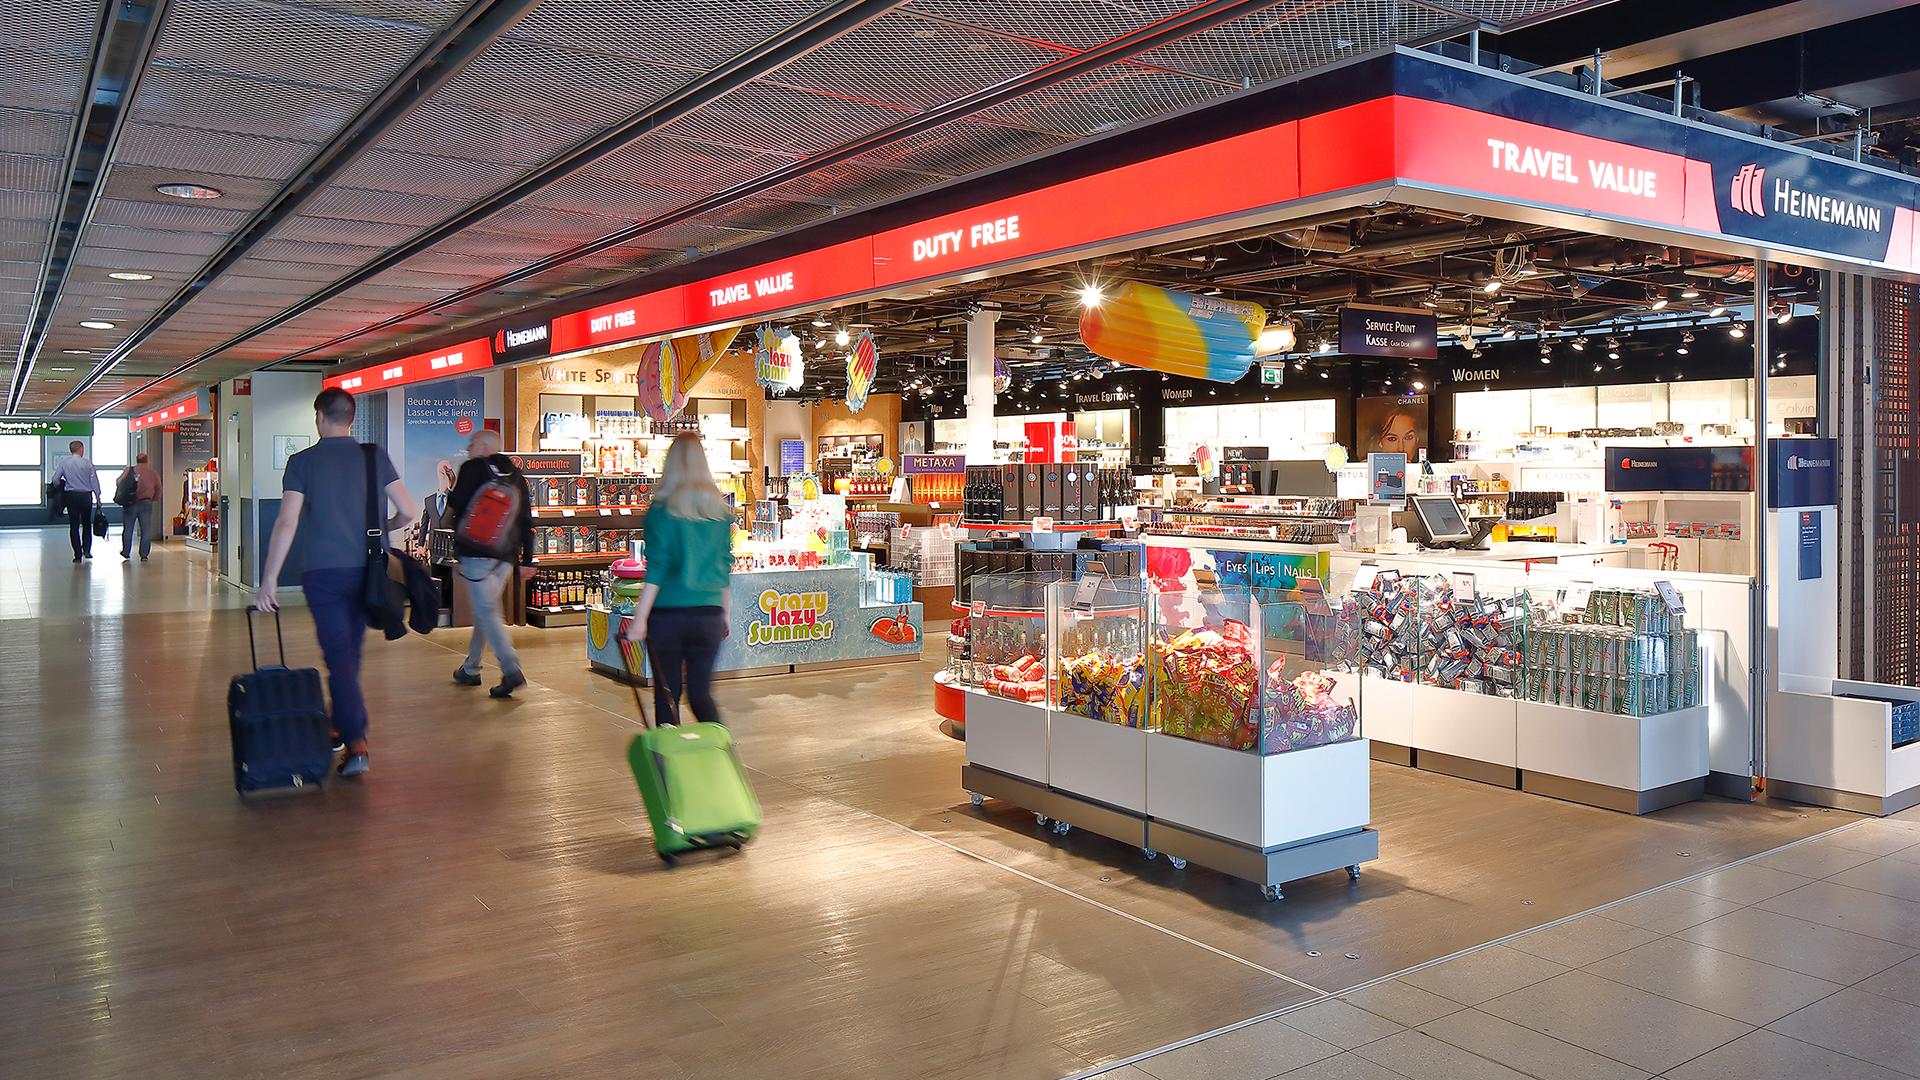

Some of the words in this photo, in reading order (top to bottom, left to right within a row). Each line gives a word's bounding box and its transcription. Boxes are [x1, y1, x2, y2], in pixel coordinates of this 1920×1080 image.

[1487, 138, 1578, 184] TRAVEL
[1588, 159, 1656, 198] VALUE
[1774, 178, 1881, 233] HEINEMANN
[913, 229, 963, 261] DUTY
[971, 215, 1019, 248] FREE
[709, 283, 751, 307] TRAVEL
[754, 271, 794, 297] VALUE
[590, 315, 613, 333] DUTY
[614, 309, 636, 328] FREE
[1365, 318, 1394, 332] SERVICE
[1395, 321, 1416, 333] POINT
[1365, 334, 1388, 346] KASSE
[1452, 368, 1500, 382] WOMEN
[407, 397, 432, 406] Beute
[445, 398, 477, 407] schwer?
[1074, 393, 1100, 403] TRAVEL
[1161, 389, 1193, 400] WOMEN
[407, 408, 435, 417] Lassen
[437, 408, 449, 417] Sie
[451, 409, 480, 417] liefern!
[913, 458, 956, 467] METAXA
[1226, 560, 1247, 573] EYES
[1255, 562, 1275, 575] LIPS
[1284, 564, 1312, 577] NAILS
[760, 591, 827, 616] Crazy
[770, 607, 815, 629] lazy
[749, 622, 831, 643] Summer
